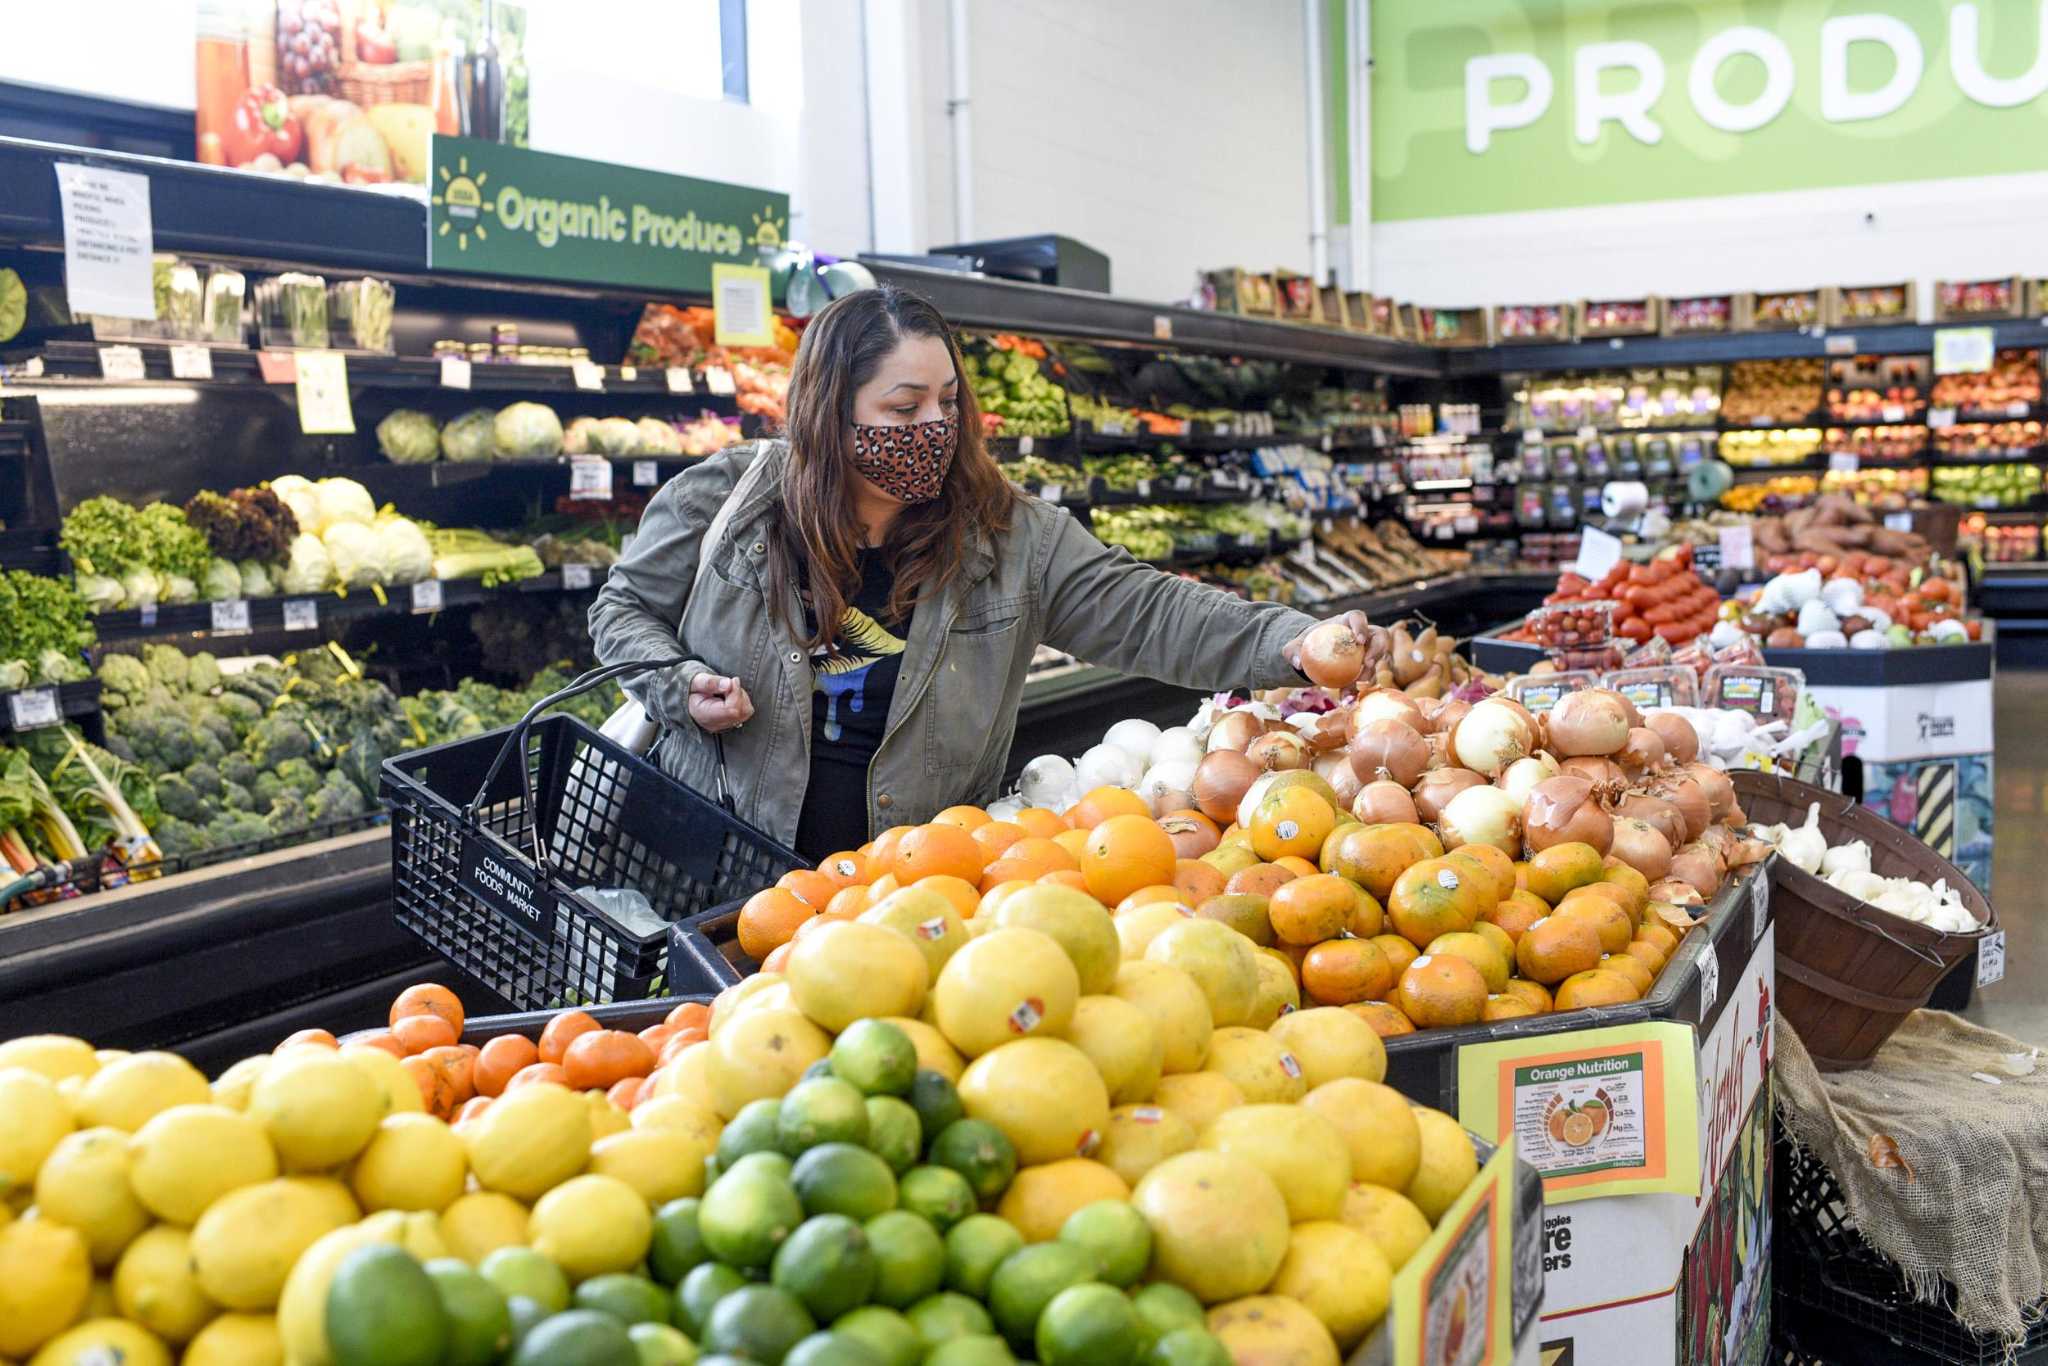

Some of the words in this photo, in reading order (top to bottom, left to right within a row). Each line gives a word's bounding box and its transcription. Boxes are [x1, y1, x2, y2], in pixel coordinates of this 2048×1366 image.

[1464, 2, 2048, 154] PRODU
[496, 186, 627, 248] Organic
[632, 203, 743, 257] Produce
[474, 866, 504, 896] FOODS
[506, 889, 542, 922] MARKET
[483, 856, 534, 900] COMMUNITY
[1530, 1066, 1576, 1081] Orange
[1577, 1059, 1629, 1075] Nutrition
